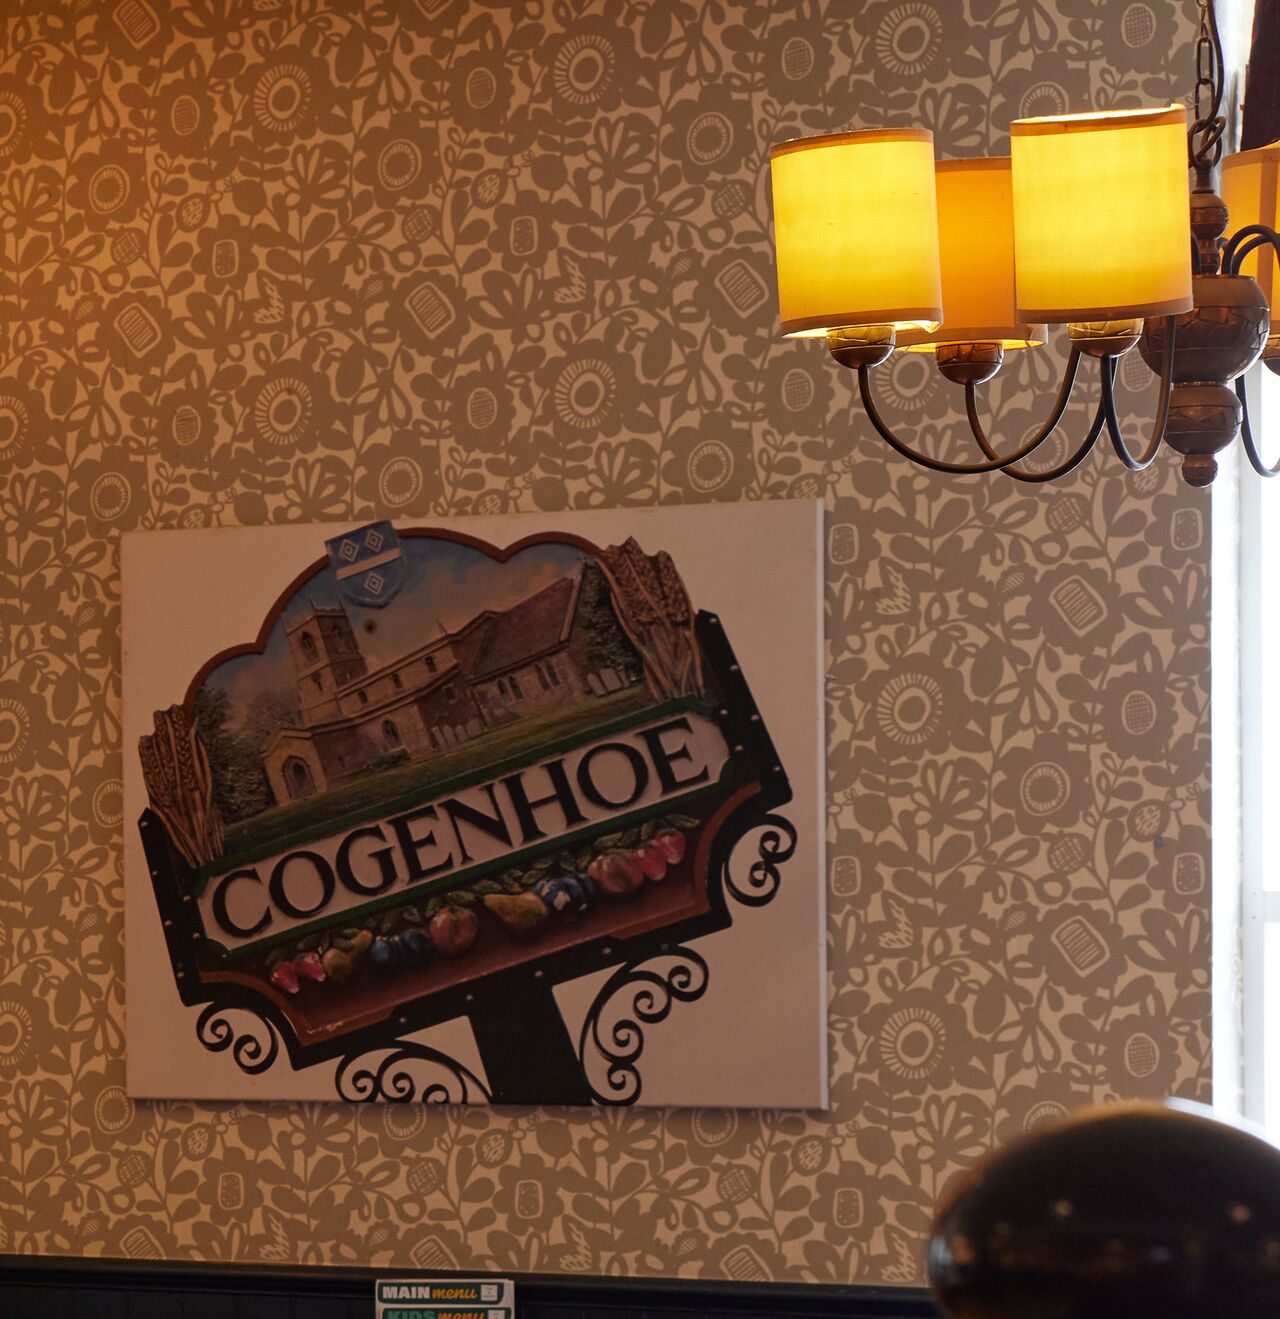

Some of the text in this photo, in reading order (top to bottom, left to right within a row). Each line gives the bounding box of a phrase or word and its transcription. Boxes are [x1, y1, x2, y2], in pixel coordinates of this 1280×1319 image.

[211, 717, 711, 939] COGENHOE
[382, 1286, 430, 1299] MAIN
[432, 1287, 478, 1299] menu
